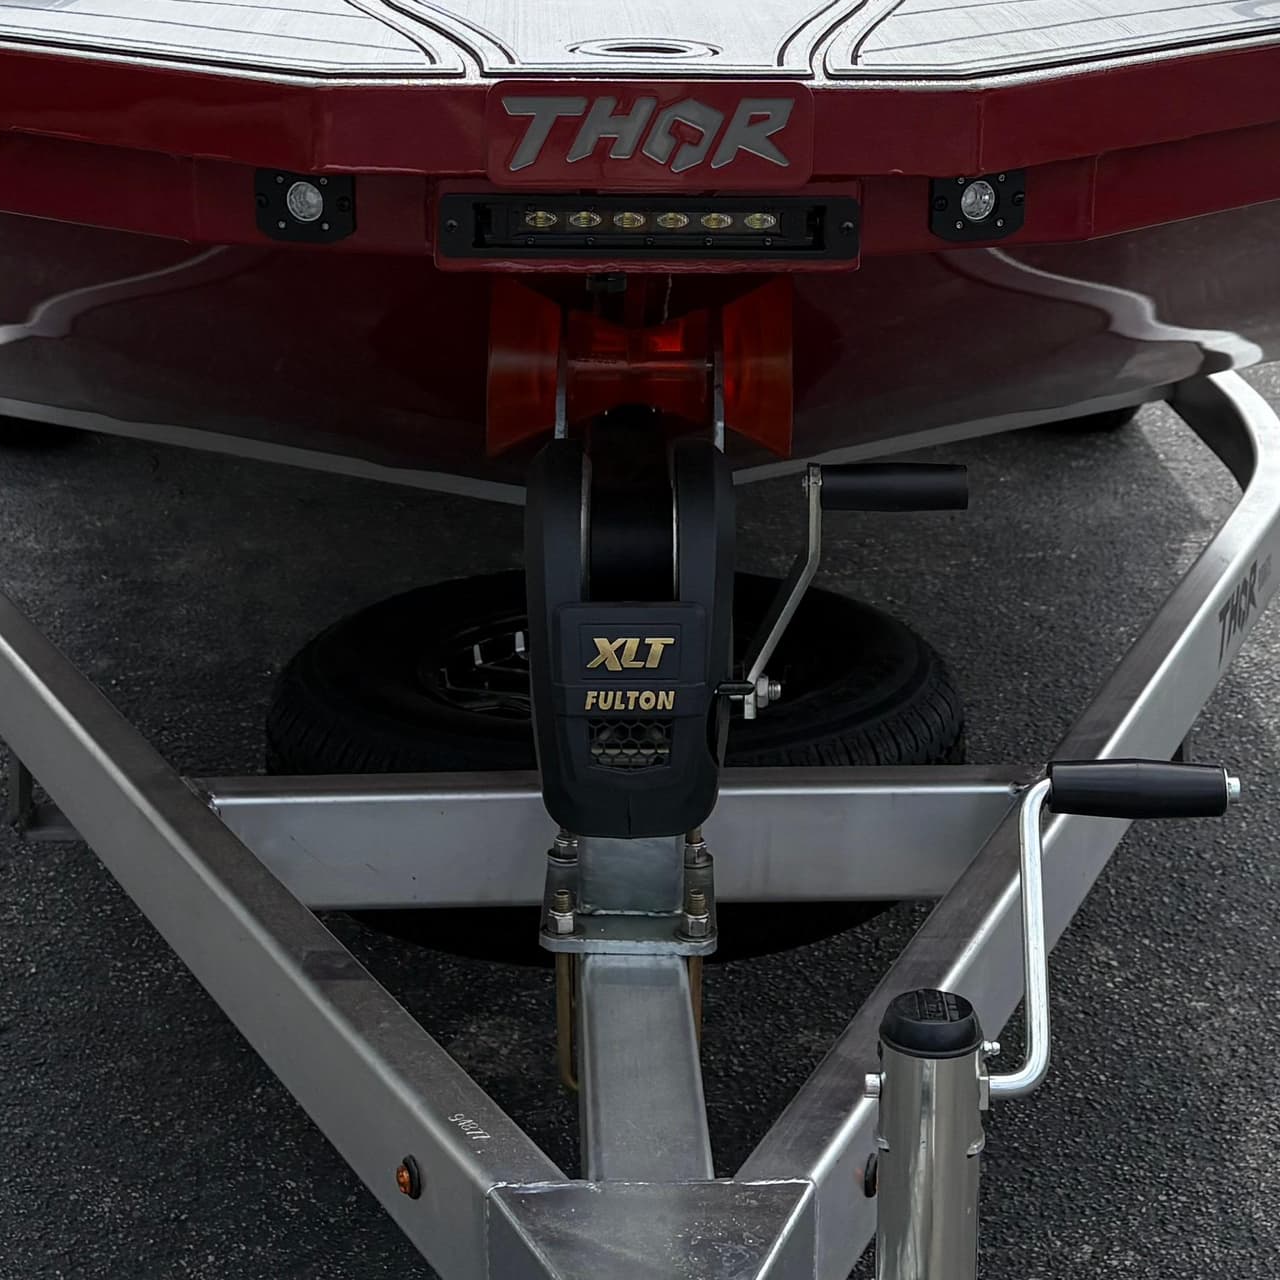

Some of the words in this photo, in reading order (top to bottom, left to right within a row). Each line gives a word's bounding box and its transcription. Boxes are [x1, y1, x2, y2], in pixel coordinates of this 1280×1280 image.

[502, 96, 796, 173] THOR
[1218, 560, 1258, 669] THOR
[586, 637, 675, 672] XLT
[584, 690, 676, 711] FULTON
